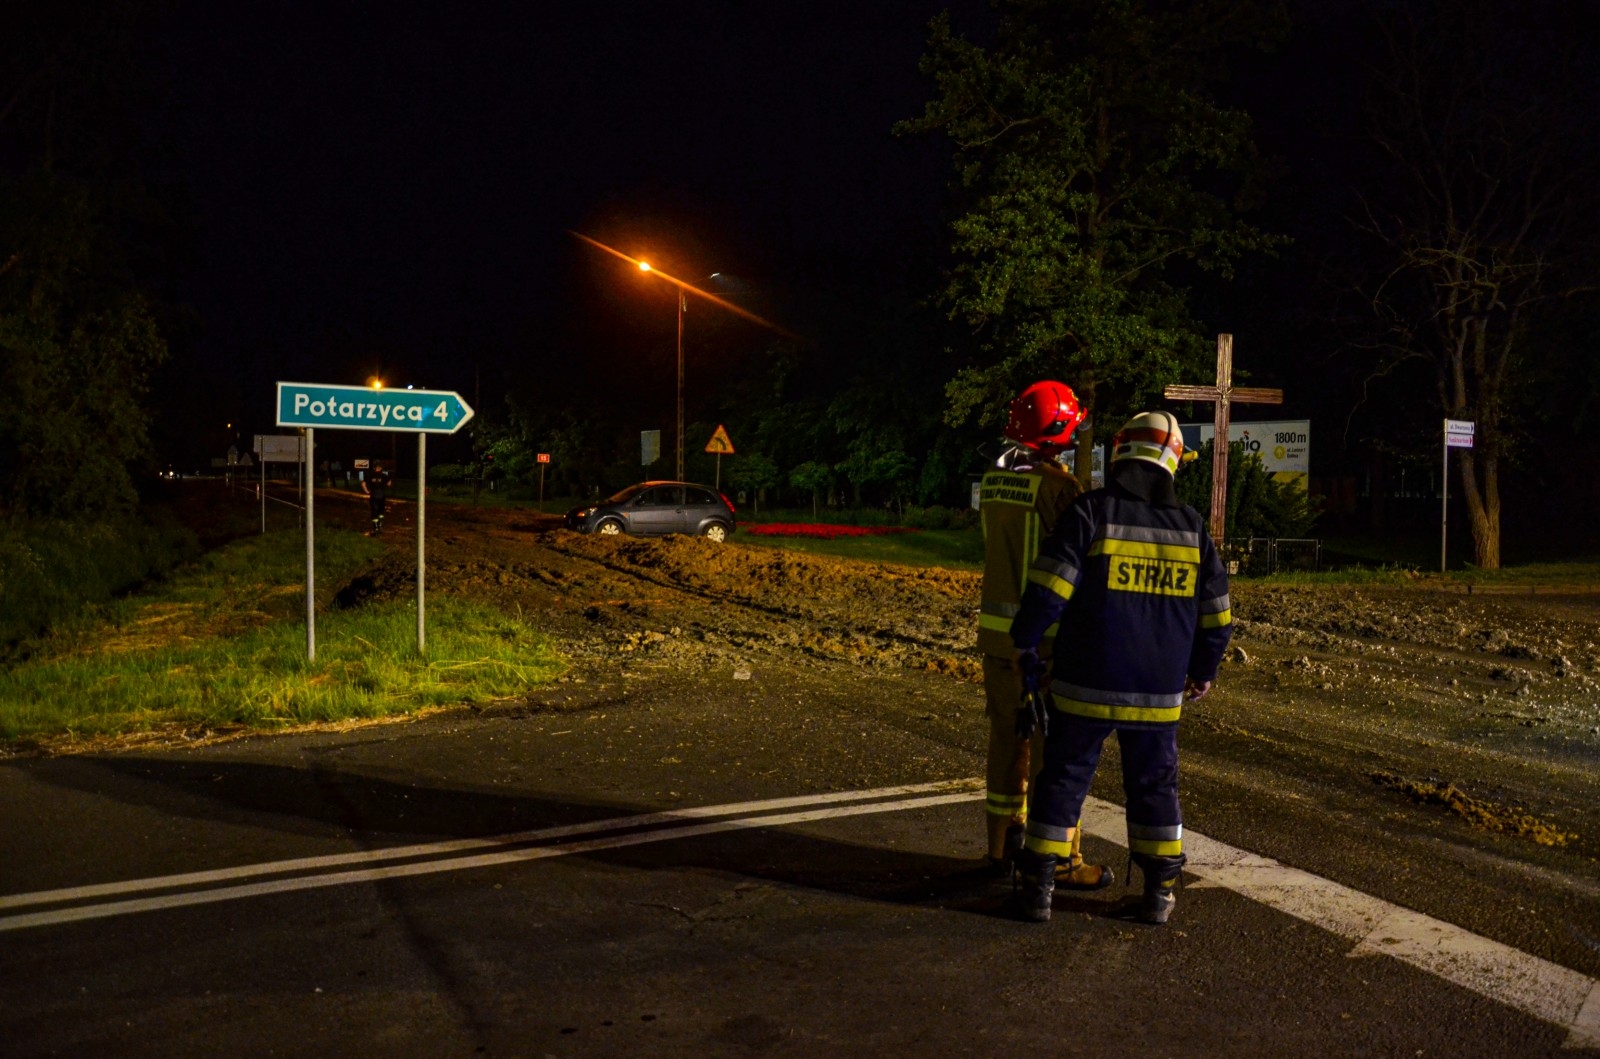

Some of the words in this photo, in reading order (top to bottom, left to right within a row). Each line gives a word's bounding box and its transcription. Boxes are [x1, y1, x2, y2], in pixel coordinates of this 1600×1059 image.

[294, 392, 423, 426] Potarzyca
[433, 400, 448, 422] 4
[1274, 432, 1296, 444] 1800
